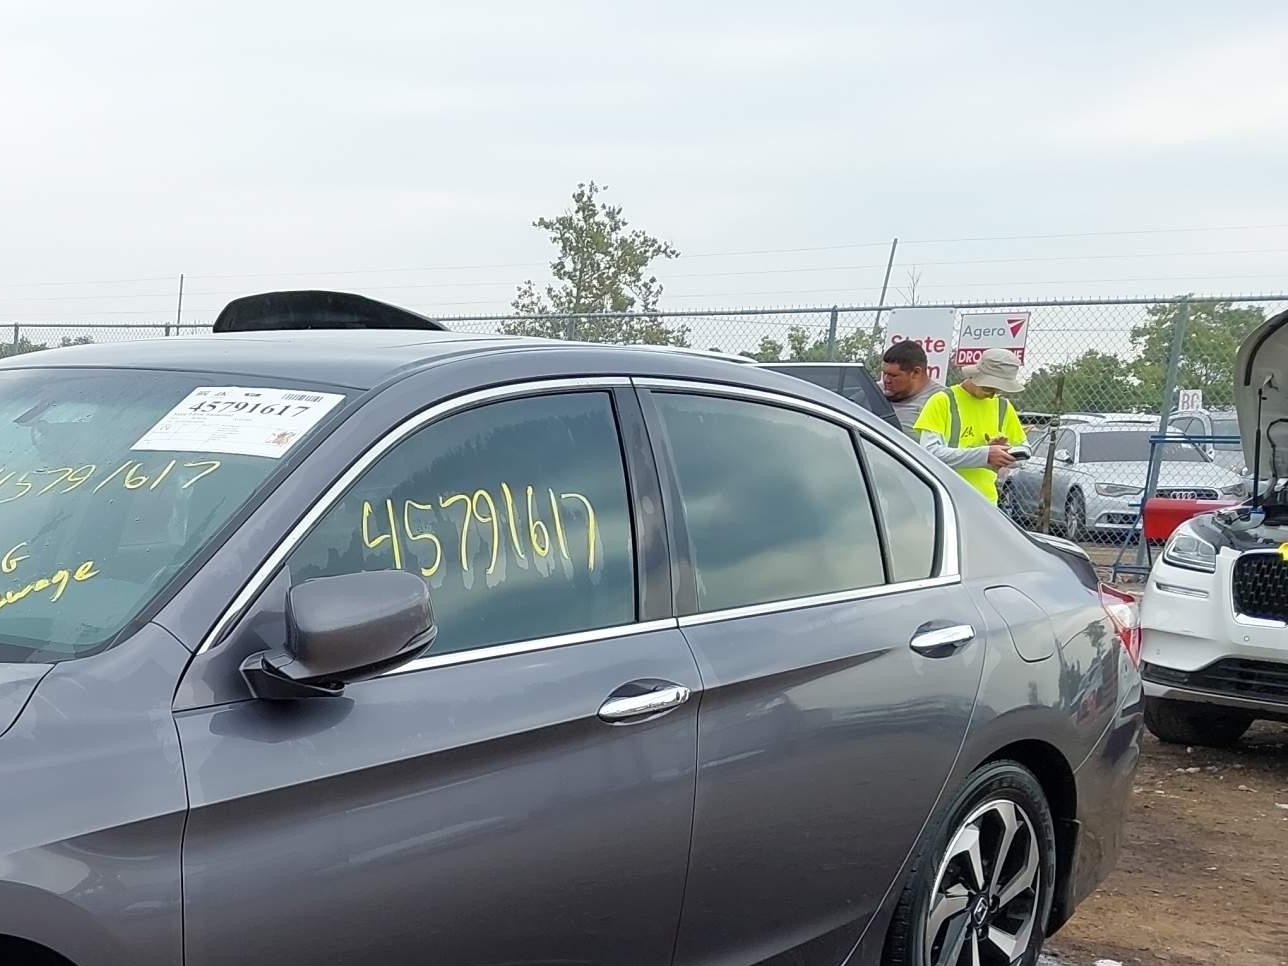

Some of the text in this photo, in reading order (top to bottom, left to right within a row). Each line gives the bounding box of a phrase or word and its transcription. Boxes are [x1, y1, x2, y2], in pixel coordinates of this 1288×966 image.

[963, 325, 1005, 340] Agero
[892, 335, 946, 353] Ste
[187, 400, 311, 417] 45791617
[363, 482, 595, 576] 45791617
